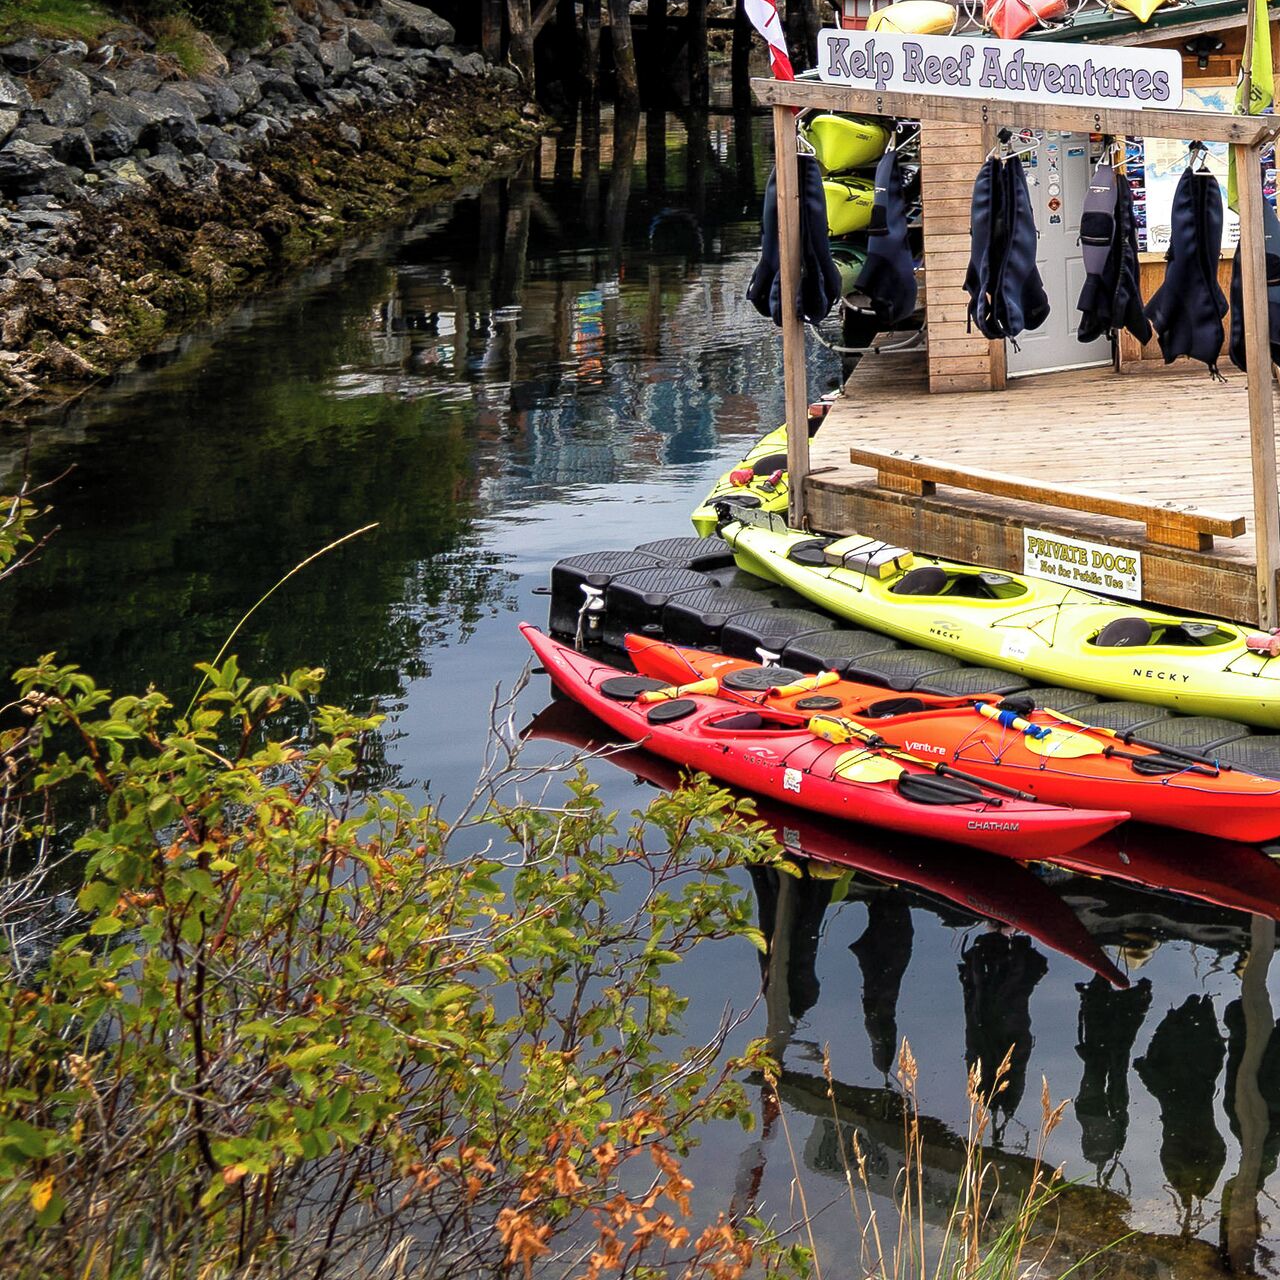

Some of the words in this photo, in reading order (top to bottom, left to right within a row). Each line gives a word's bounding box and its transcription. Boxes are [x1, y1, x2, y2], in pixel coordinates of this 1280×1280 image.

[826, 37, 894, 91] Kelp
[903, 43, 974, 87] Reef
[979, 47, 1170, 101] Adventures
[1027, 536, 1088, 567] PRIVATE
[1092, 550, 1137, 576] DOCK
[1040, 560, 1056, 574] Not
[1058, 564, 1071, 578] for
[1073, 568, 1103, 586] Public
[1104, 574, 1124, 589] Use
[929, 628, 961, 641] NECKY
[1133, 669, 1190, 683] NECKY
[905, 741, 946, 755] Venture
[967, 820, 1020, 831] CHATHAM
